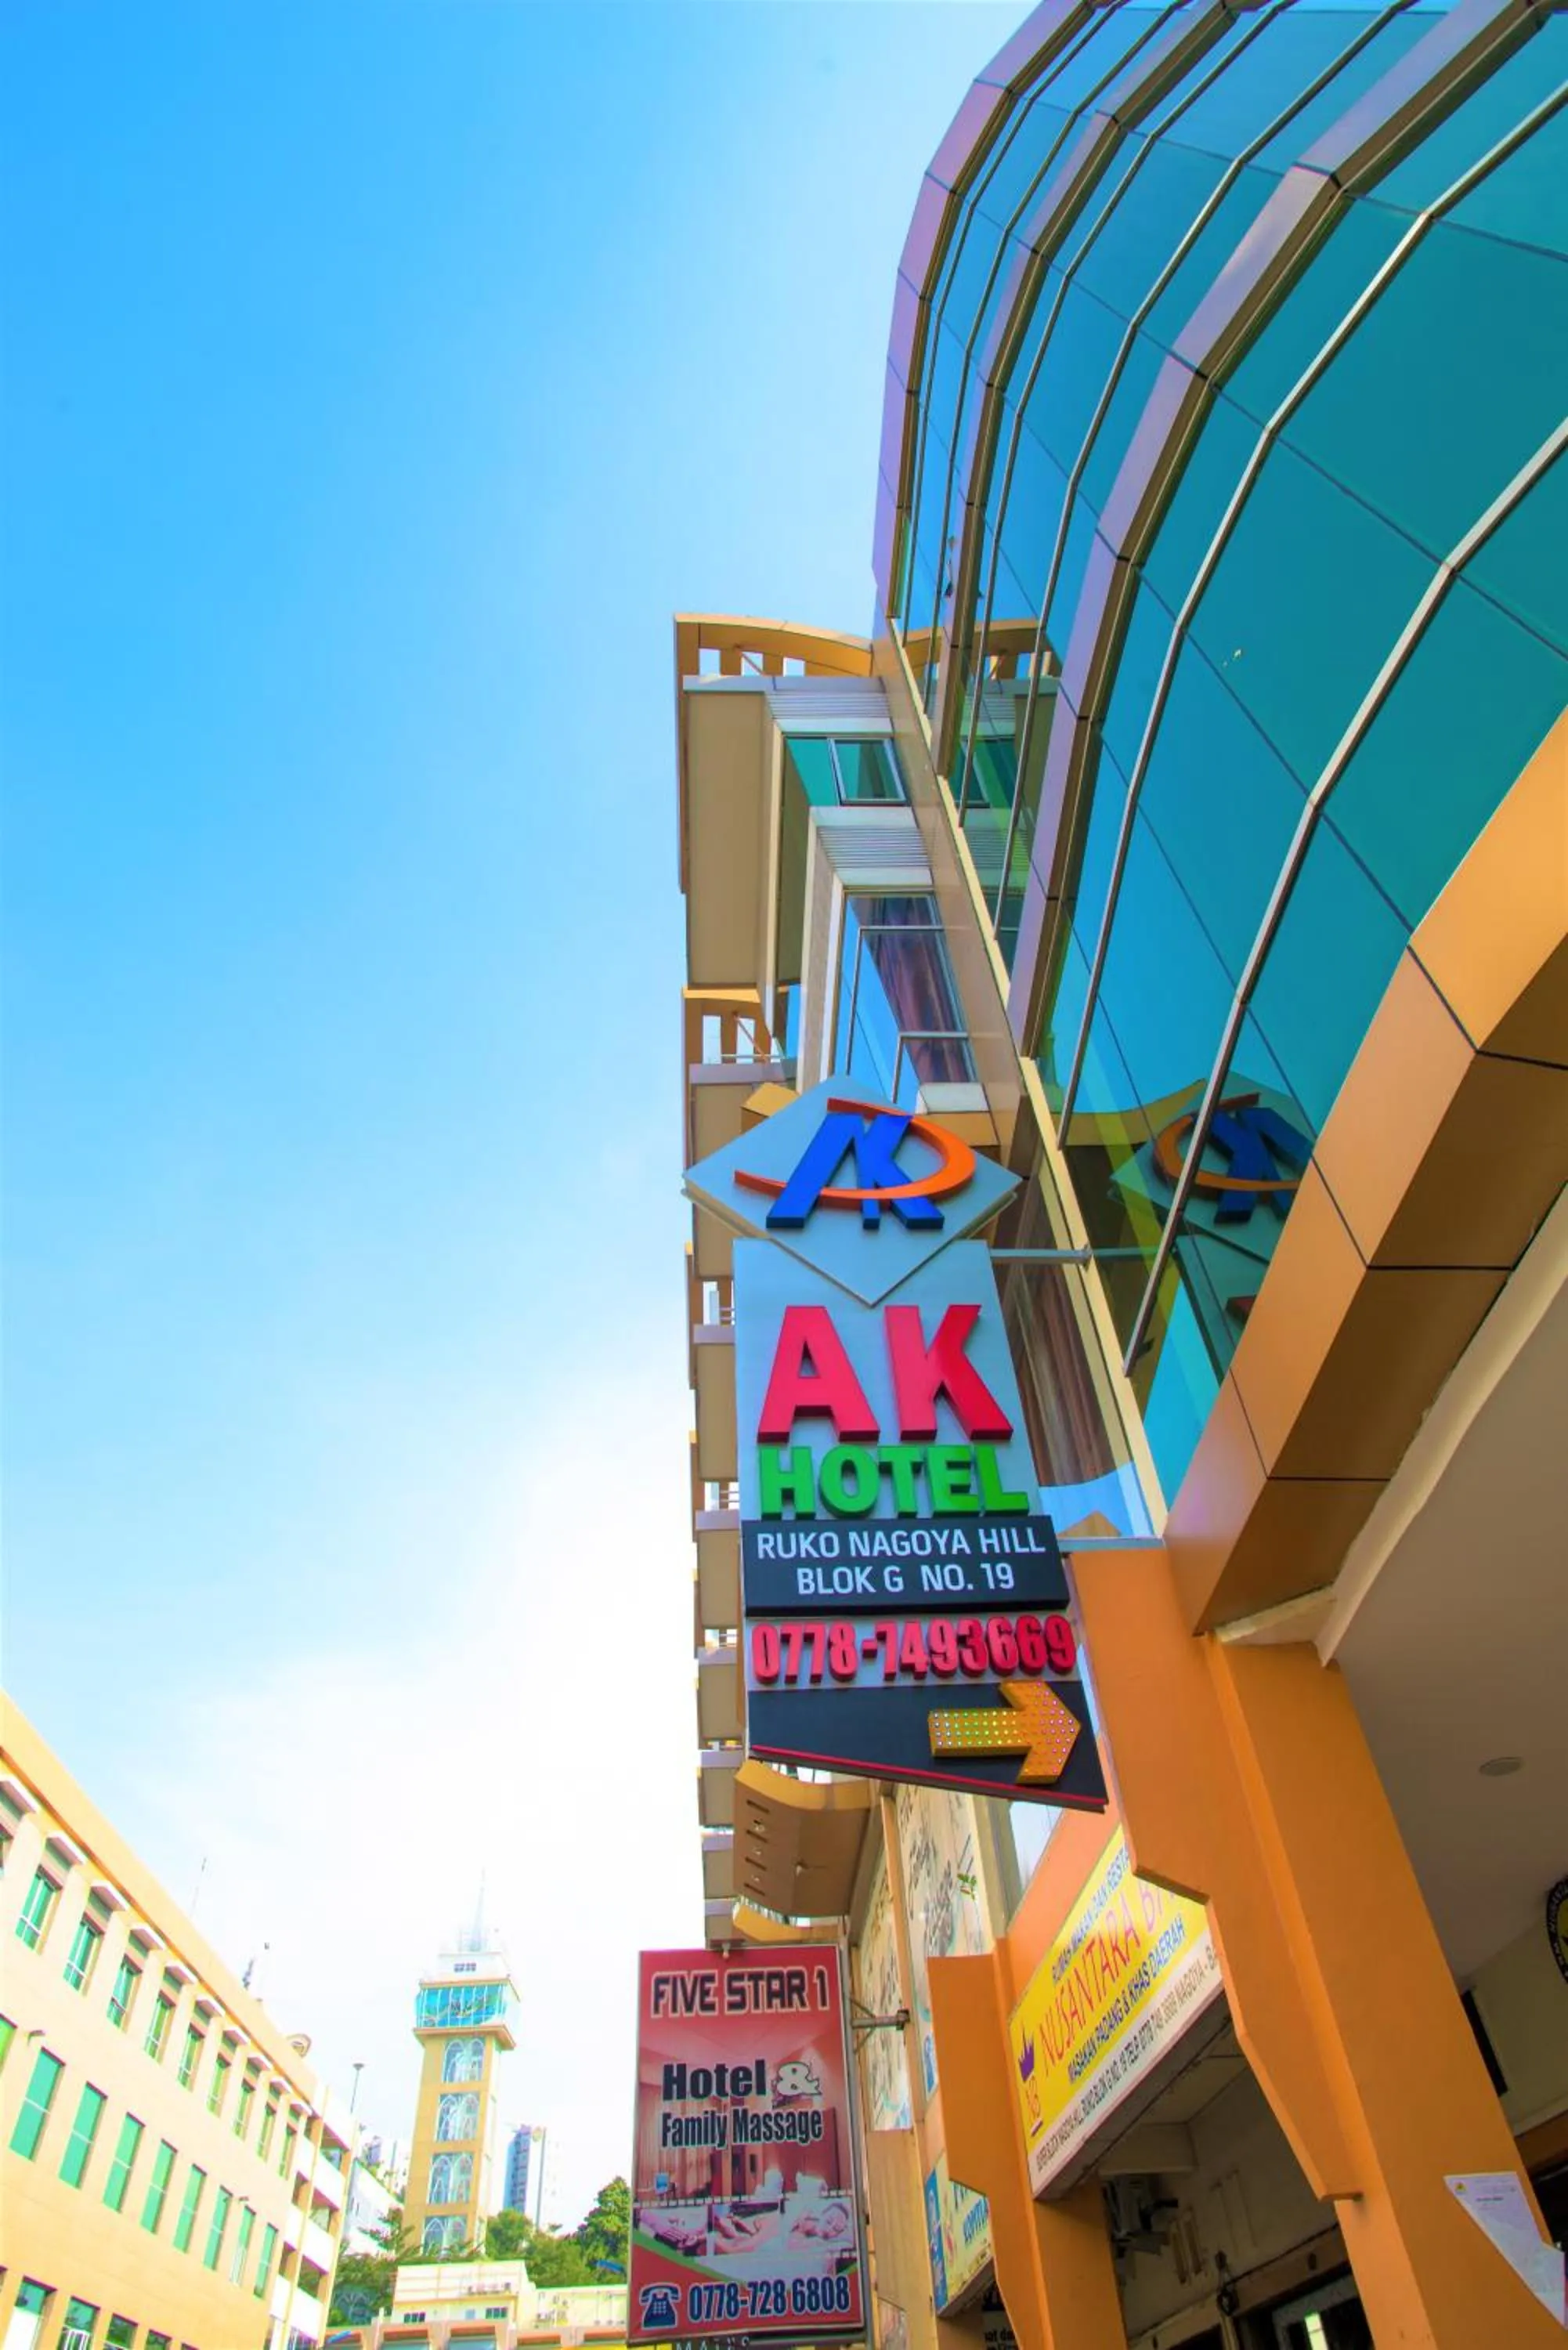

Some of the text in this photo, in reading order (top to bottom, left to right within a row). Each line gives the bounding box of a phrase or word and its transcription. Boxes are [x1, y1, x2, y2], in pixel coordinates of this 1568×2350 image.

[757, 1304, 1013, 1444] AK
[757, 1445, 1030, 1521] HOTEL
[757, 1527, 1046, 1560] RUKO NAGOYA HILL
[797, 1562, 1015, 1595] BLOK G NO. 19
[751, 1614, 1077, 1683] 0778-7493669
[1147, 1910, 1186, 1981] DAERAH
[651, 1965, 829, 2018] FIVE STAR 1
[1038, 1888, 1142, 2079] NUSANTARA
[663, 2059, 767, 2101] Hotel
[662, 2107, 823, 2149] Family Massage
[688, 2276, 850, 2323] 0778-728 6808
